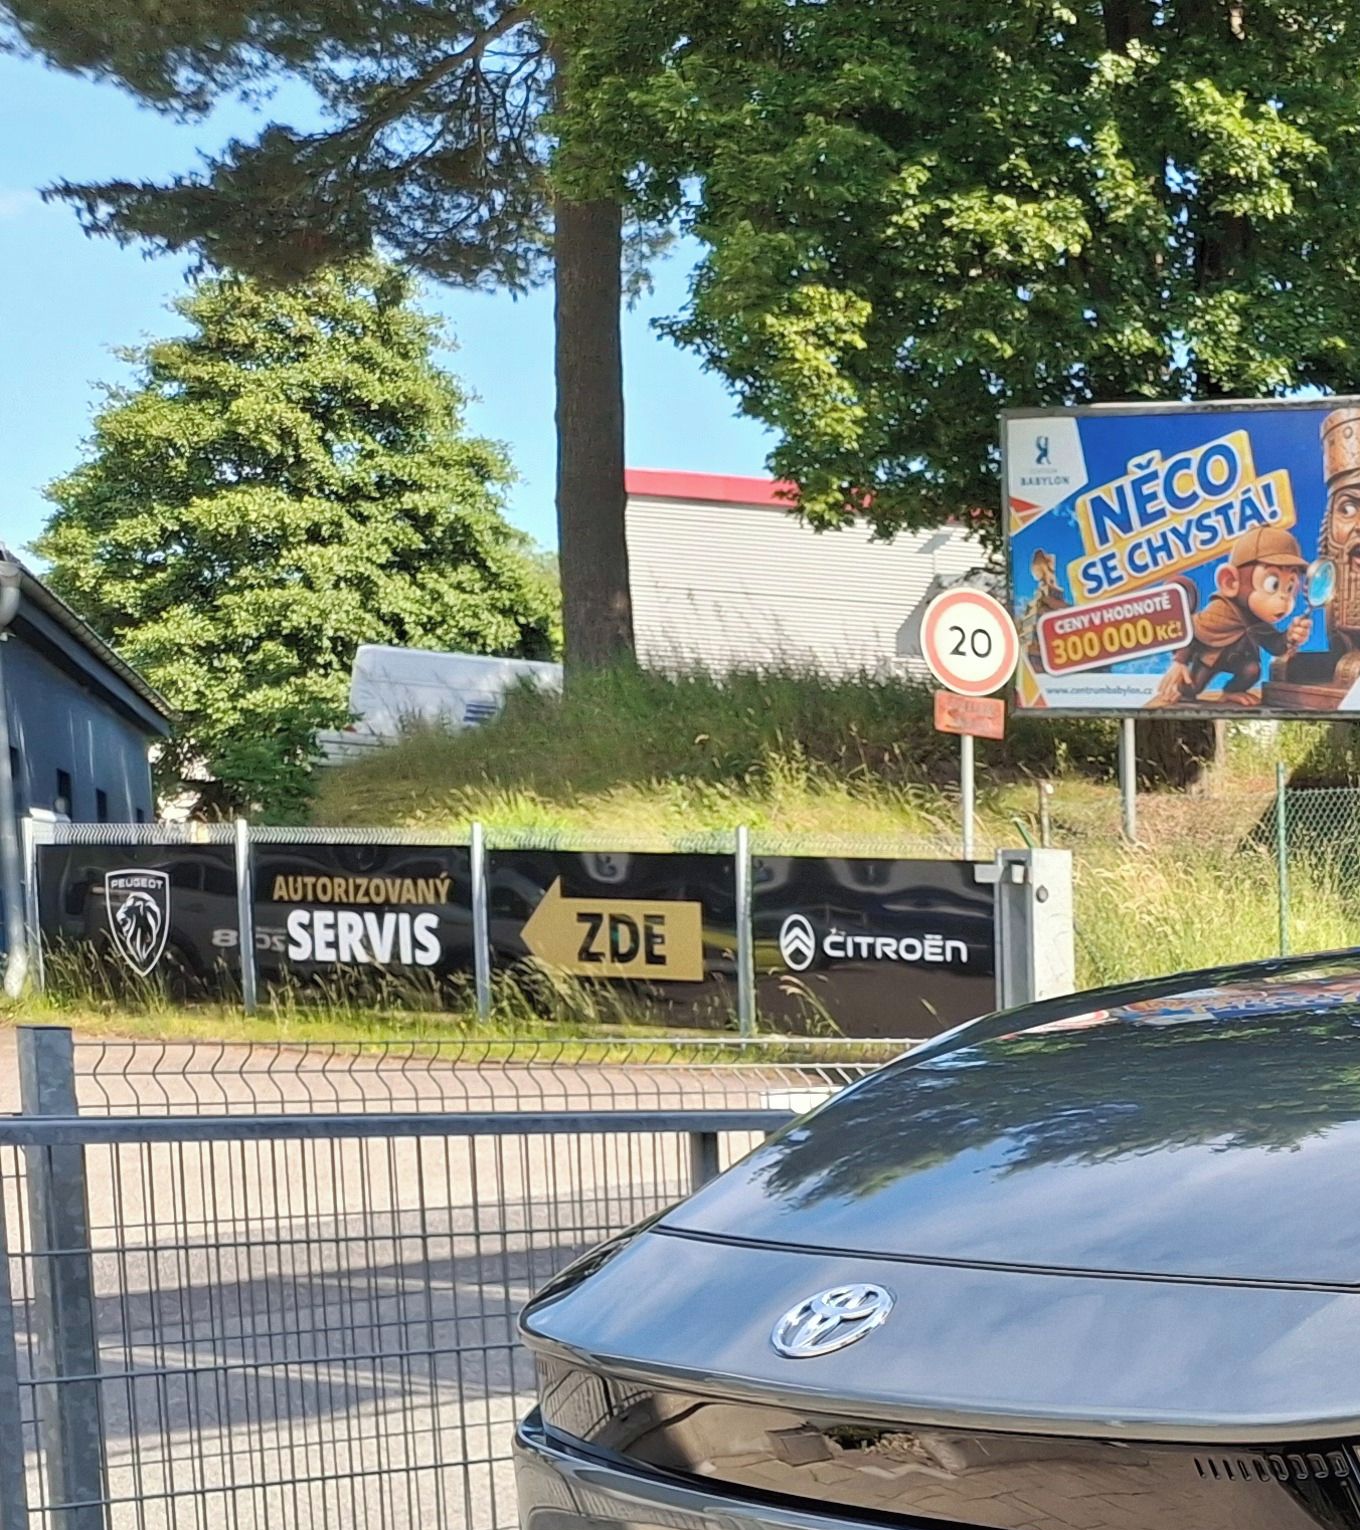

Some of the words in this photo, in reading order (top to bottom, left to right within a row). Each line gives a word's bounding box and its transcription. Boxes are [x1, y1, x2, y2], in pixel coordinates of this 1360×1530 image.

[1021, 476, 1070, 486] BABYLON
[1089, 443, 1238, 546] NĚCO
[1081, 553, 1124, 595] SE
[1127, 481, 1280, 573] CHYSTÁ!
[1054, 614, 1091, 634] CENY
[1091, 612, 1103, 626] V
[1102, 593, 1171, 623] HODNOTĚ
[949, 625, 992, 658] 20
[1052, 631, 1099, 665] 300
[1103, 619, 1154, 653] 000
[1046, 686, 1153, 696] www.centrumbabylon.cz
[110, 877, 164, 889] PEUGEOT
[273, 872, 451, 904] AUTORIZOVANÝ
[287, 909, 441, 966] SERVIS
[576, 912, 667, 965] ZDE
[823, 932, 968, 963] CITROËN
